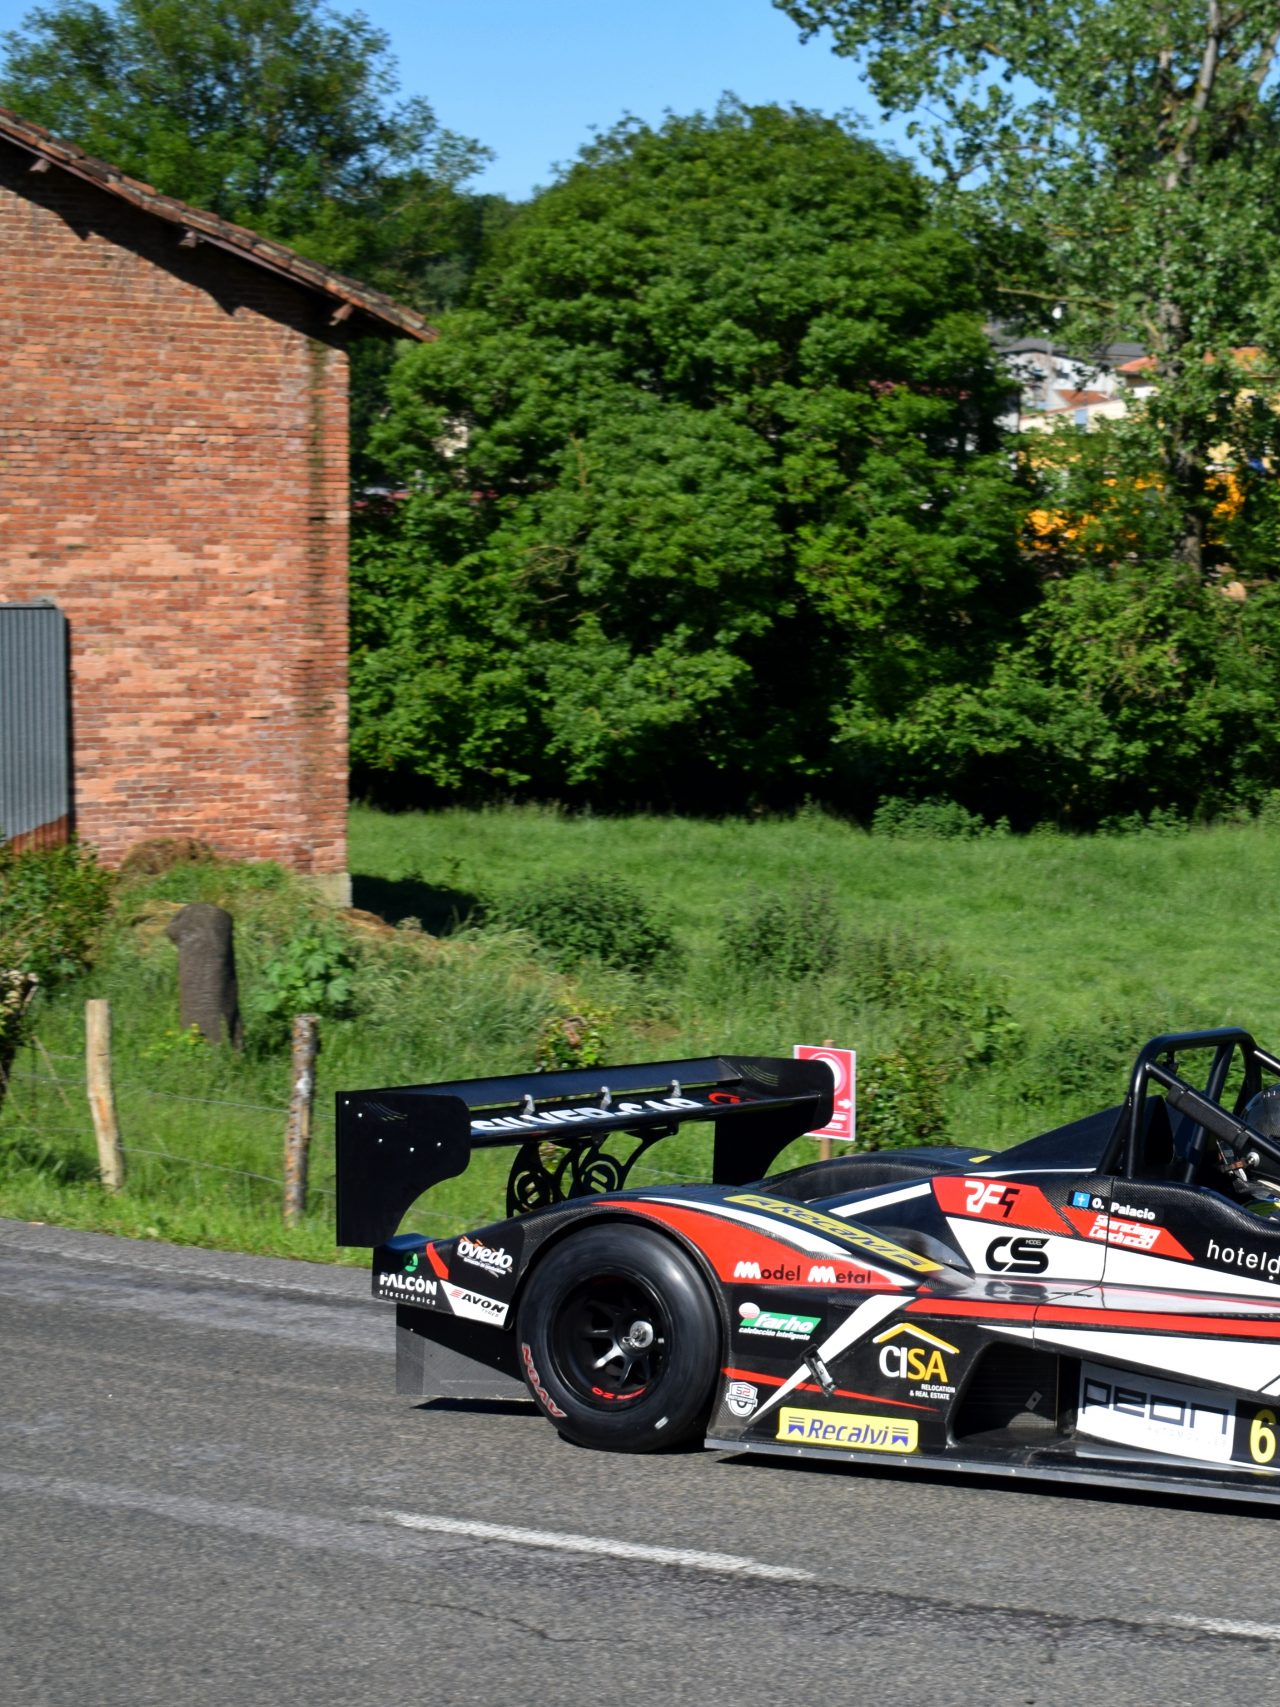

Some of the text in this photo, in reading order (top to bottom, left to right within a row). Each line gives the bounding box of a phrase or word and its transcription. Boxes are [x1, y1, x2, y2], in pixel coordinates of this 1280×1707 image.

[1110, 1202, 1155, 1220] Palacio
[985, 1236, 1050, 1274] CS
[734, 1261, 871, 1285] Model Metal
[379, 1288, 436, 1305] electrónica
[461, 1293, 505, 1313] AVON
[753, 1314, 814, 1332] farho
[879, 1345, 948, 1382] CISA
[921, 1383, 956, 1393] RELOCATION
[930, 1392, 950, 1400] ESTATE
[807, 1418, 889, 1446] Recalvi
[1251, 1409, 1276, 1463] 6
